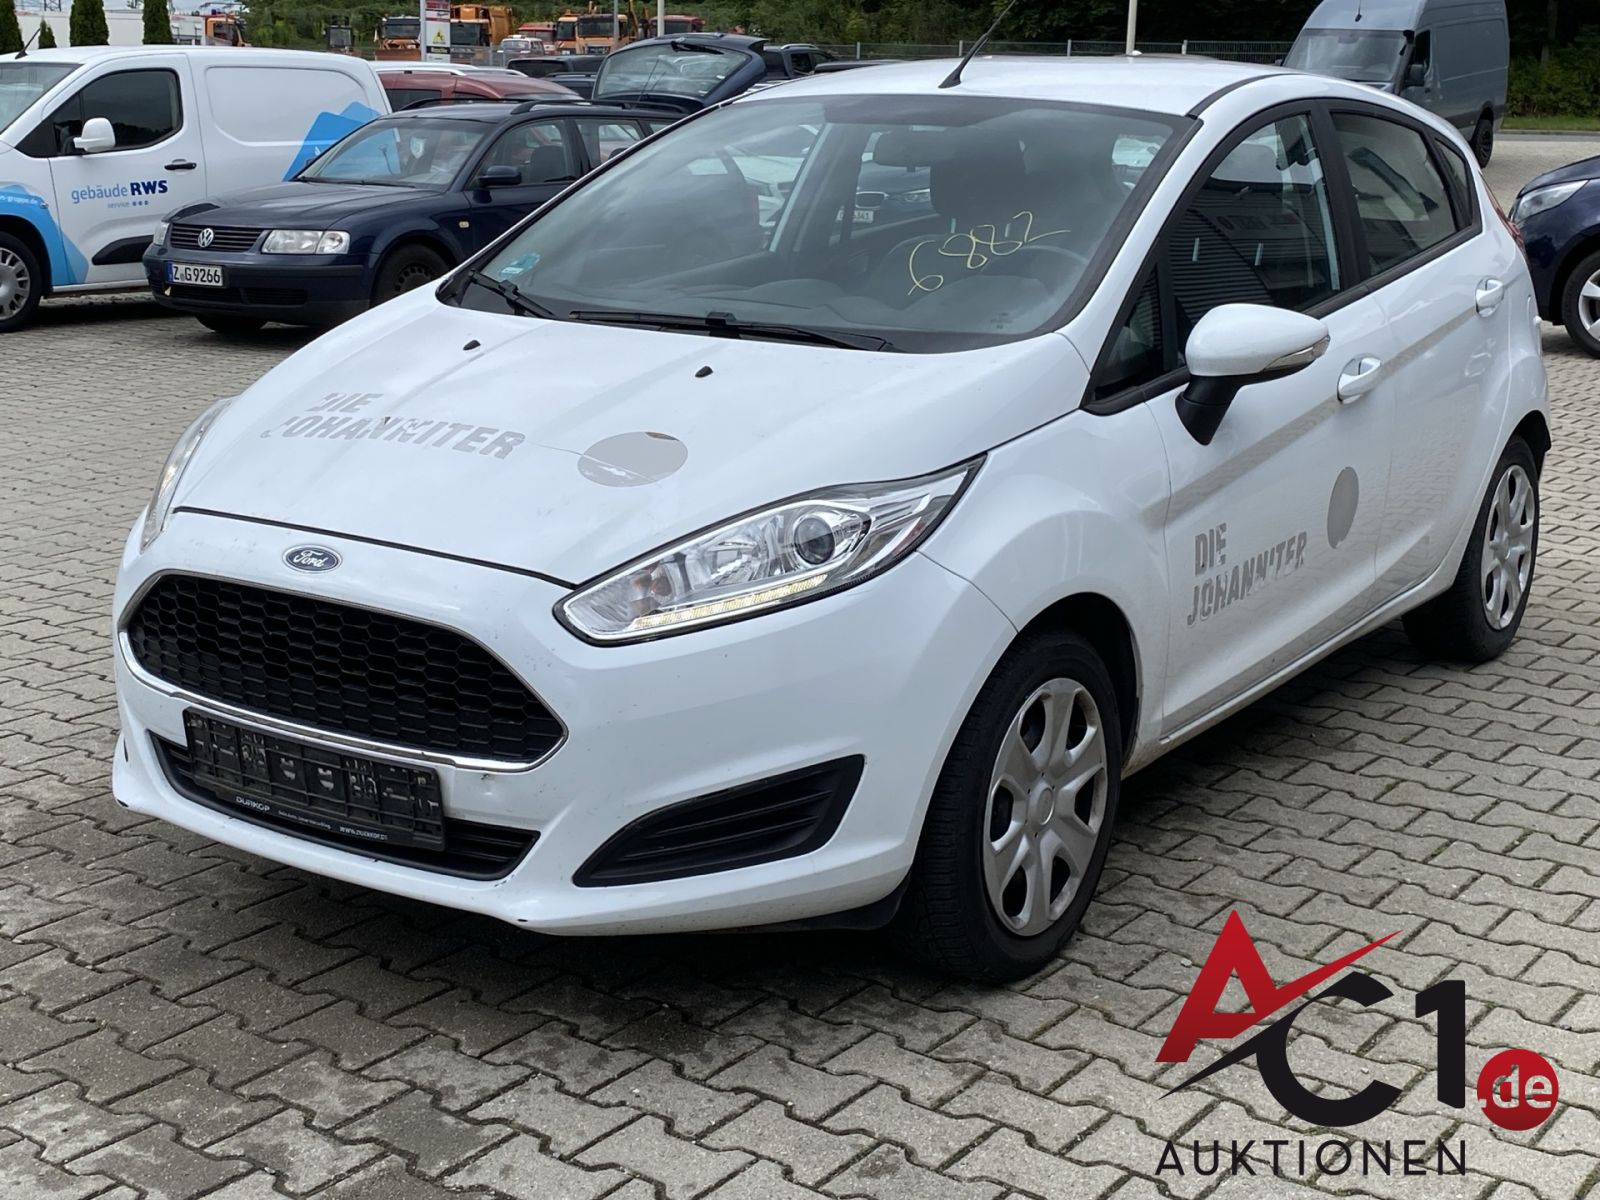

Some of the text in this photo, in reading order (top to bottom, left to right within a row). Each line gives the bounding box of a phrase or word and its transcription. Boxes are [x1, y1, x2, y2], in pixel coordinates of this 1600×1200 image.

[71, 180, 168, 204] gebäude RWS
[907, 210, 1072, 296] 6882
[292, 549, 329, 568] Ford
[1194, 522, 1228, 577] DIE
